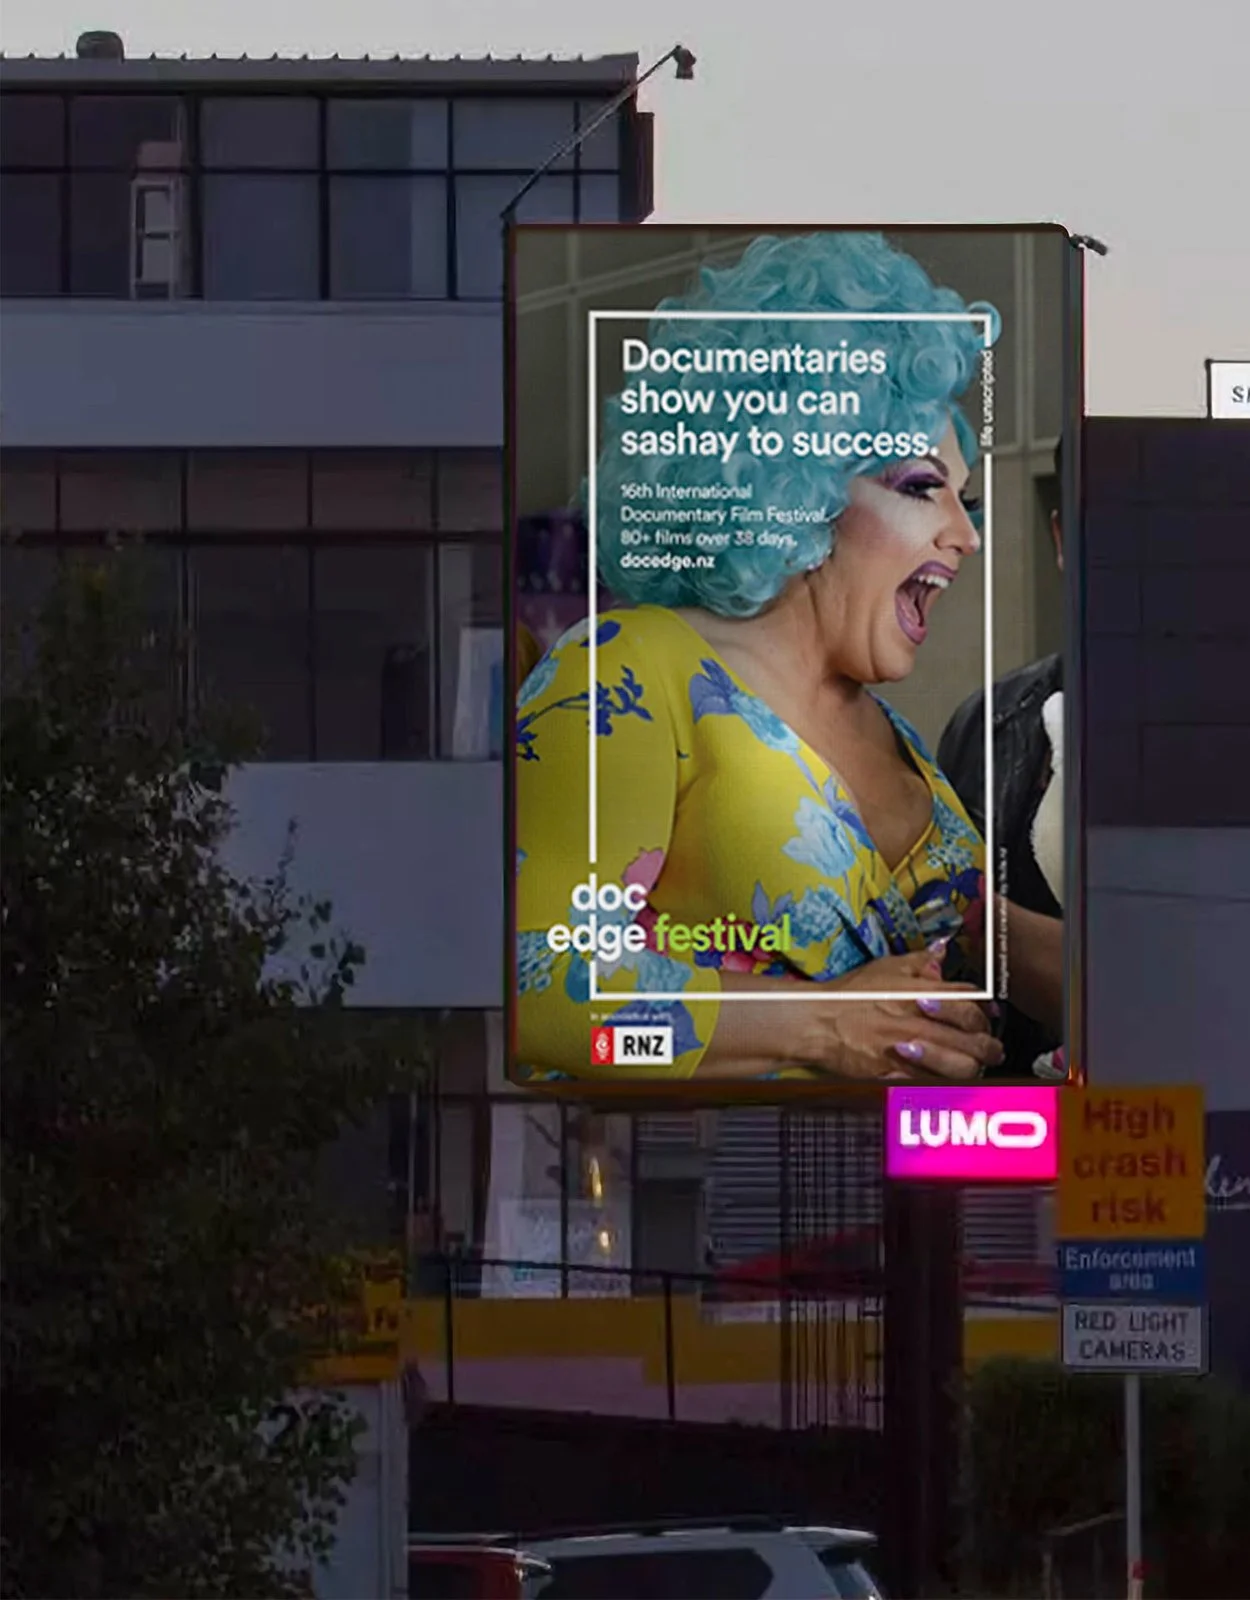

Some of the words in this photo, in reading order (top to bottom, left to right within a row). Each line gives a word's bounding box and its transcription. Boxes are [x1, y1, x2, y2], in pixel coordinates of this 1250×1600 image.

[623, 339, 886, 374] Documentaries
[621, 380, 715, 414] show
[723, 389, 787, 421] you
[797, 389, 859, 414] can
[980, 349, 995, 423] unscripted
[621, 422, 739, 463] sashay
[748, 426, 784, 455] to
[793, 430, 939, 456] success.
[621, 483, 653, 499] 16th
[656, 483, 752, 499] International
[621, 506, 726, 525] Documentary
[730, 506, 763, 522] Film
[621, 530, 650, 545] 80+
[655, 529, 692, 545] films
[696, 533, 730, 546] over
[734, 530, 752, 546] 38
[621, 553, 715, 572] docedge.nz
[572, 873, 647, 911] doc
[547, 913, 647, 962] edge
[654, 913, 792, 952] festival
[623, 1035, 665, 1057] RNZ
[899, 1109, 1048, 1149] LUMO
[1084, 1097, 1175, 1139] High
[1073, 1146, 1187, 1178] crash
[1091, 1189, 1166, 1224] risk
[1066, 1246, 1196, 1270] Enforcement
[1109, 1273, 1155, 1290] area
[1075, 1311, 1116, 1331] RED
[1130, 1311, 1189, 1333] LIGHT
[1080, 1340, 1187, 1361] CAMERAS
